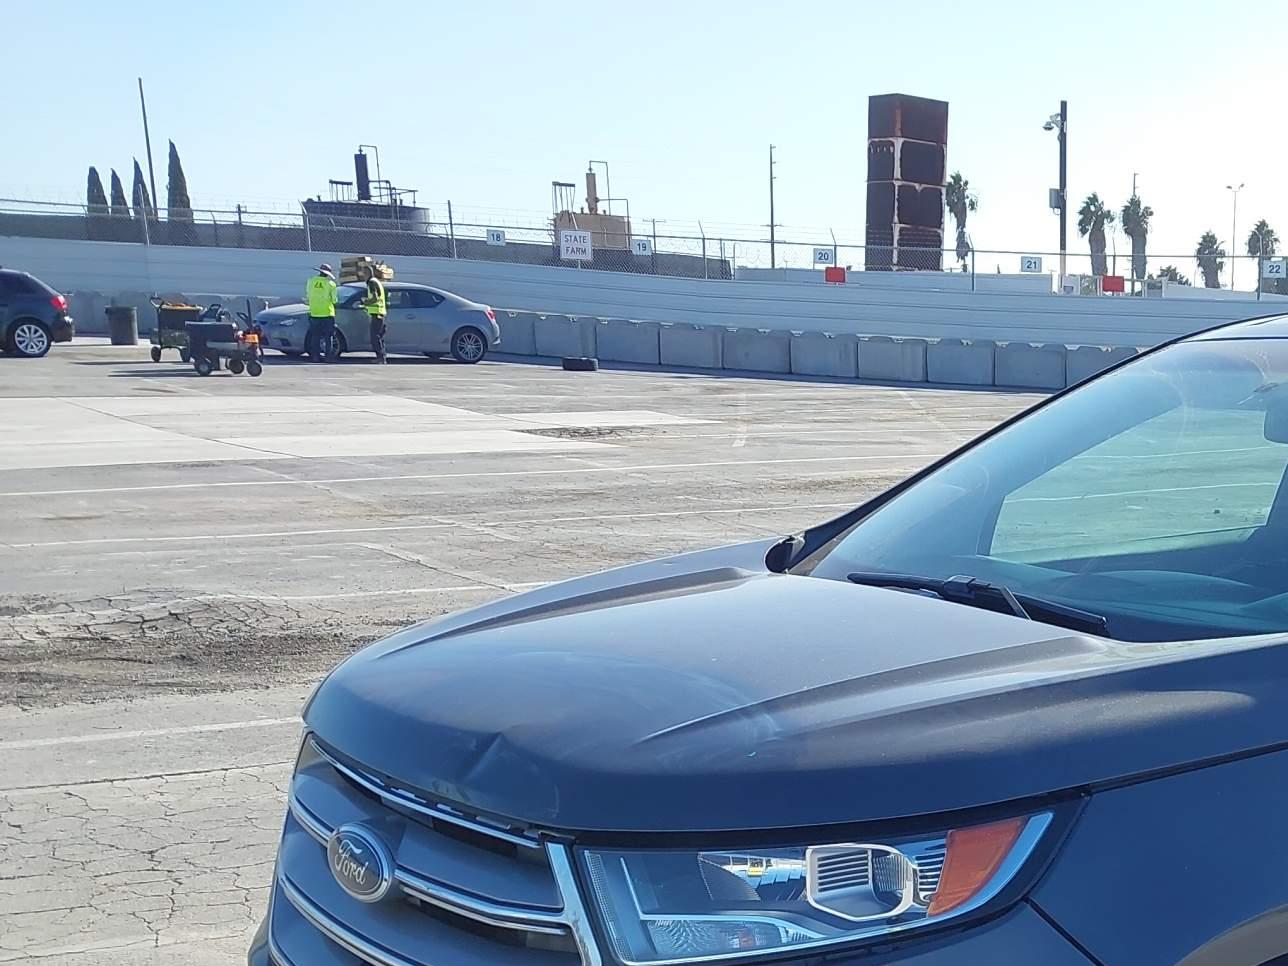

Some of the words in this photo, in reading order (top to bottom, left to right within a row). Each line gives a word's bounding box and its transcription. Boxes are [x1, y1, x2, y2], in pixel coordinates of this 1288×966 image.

[491, 232, 501, 243] 18
[564, 234, 588, 244] STATE
[565, 246, 587, 256] FARM
[636, 242, 647, 252] 19
[817, 251, 829, 261] 20
[1026, 259, 1038, 269] 21
[1268, 264, 1281, 274] 22
[334, 839, 369, 885] Ford
